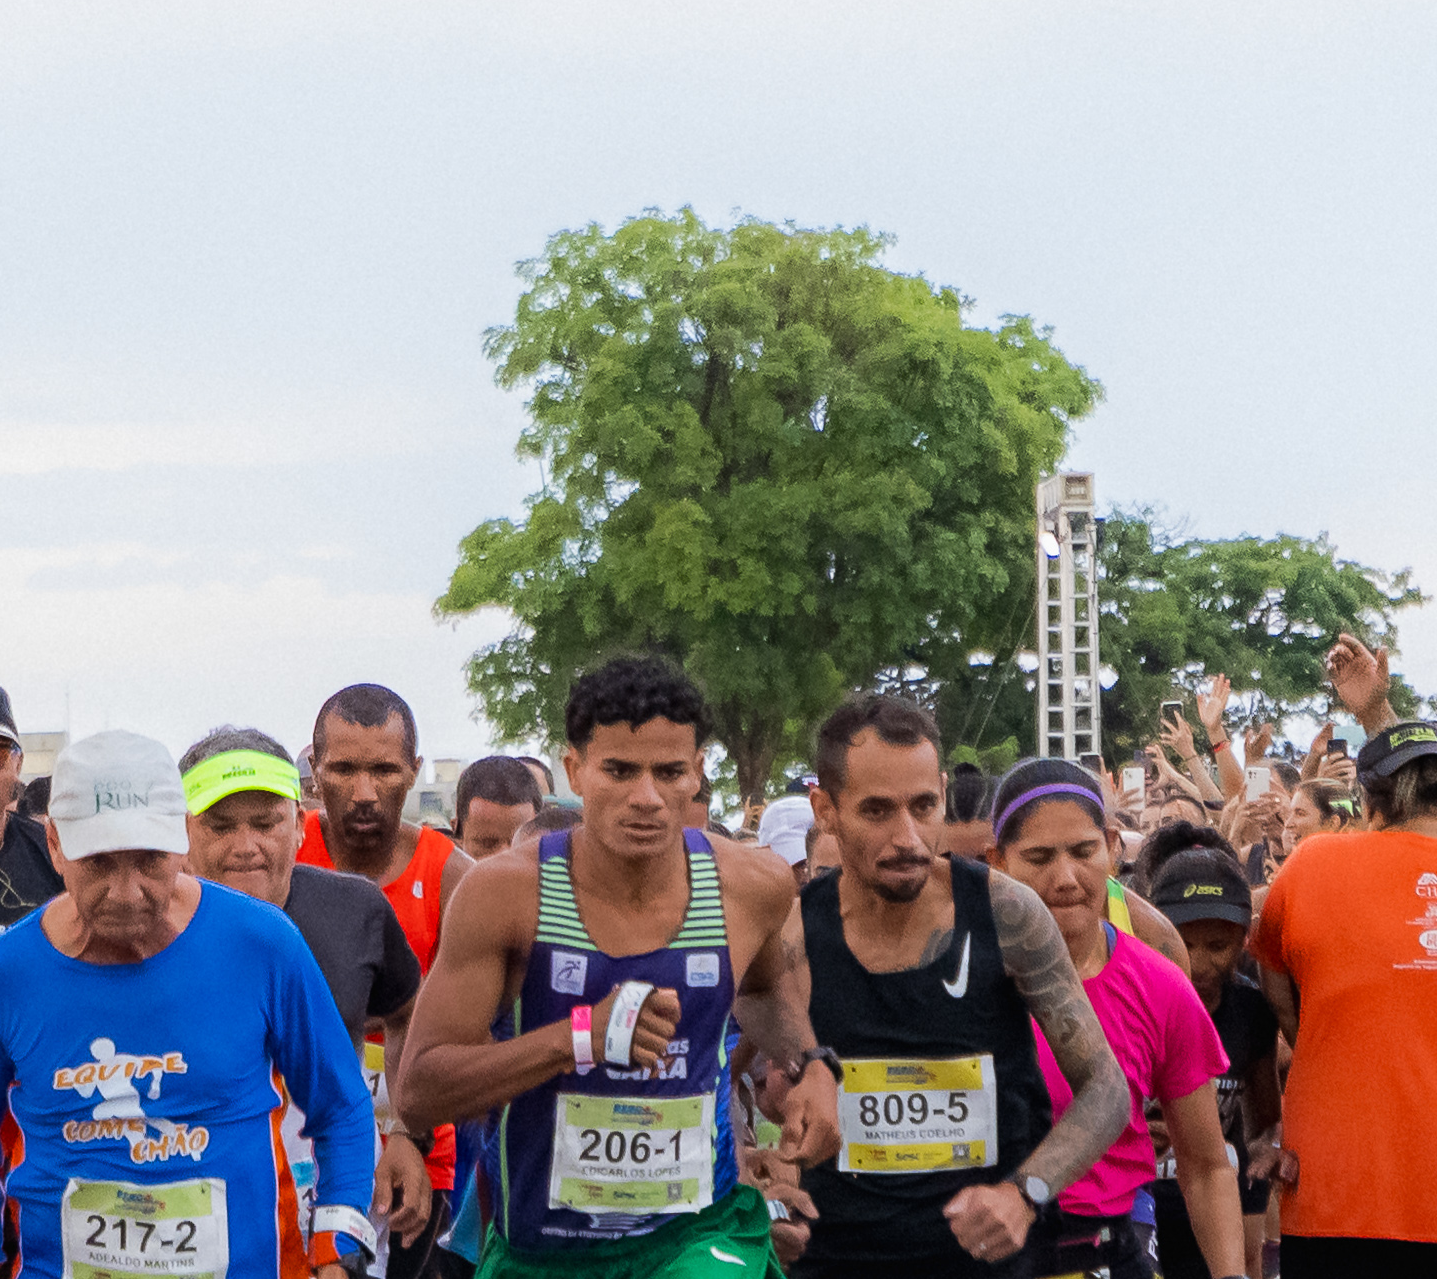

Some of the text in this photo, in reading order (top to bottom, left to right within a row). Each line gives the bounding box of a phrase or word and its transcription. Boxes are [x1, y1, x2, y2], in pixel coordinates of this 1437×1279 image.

[54, 1052, 187, 1089] EQUIPE
[859, 1092, 969, 1127] 809-5
[63, 1117, 146, 1142] COME
[131, 1123, 209, 1164] CHÃO
[579, 1128, 682, 1163] 206-1
[865, 1127, 965, 1141] MATHEUS COELHO
[85, 1214, 197, 1253] 217-2
